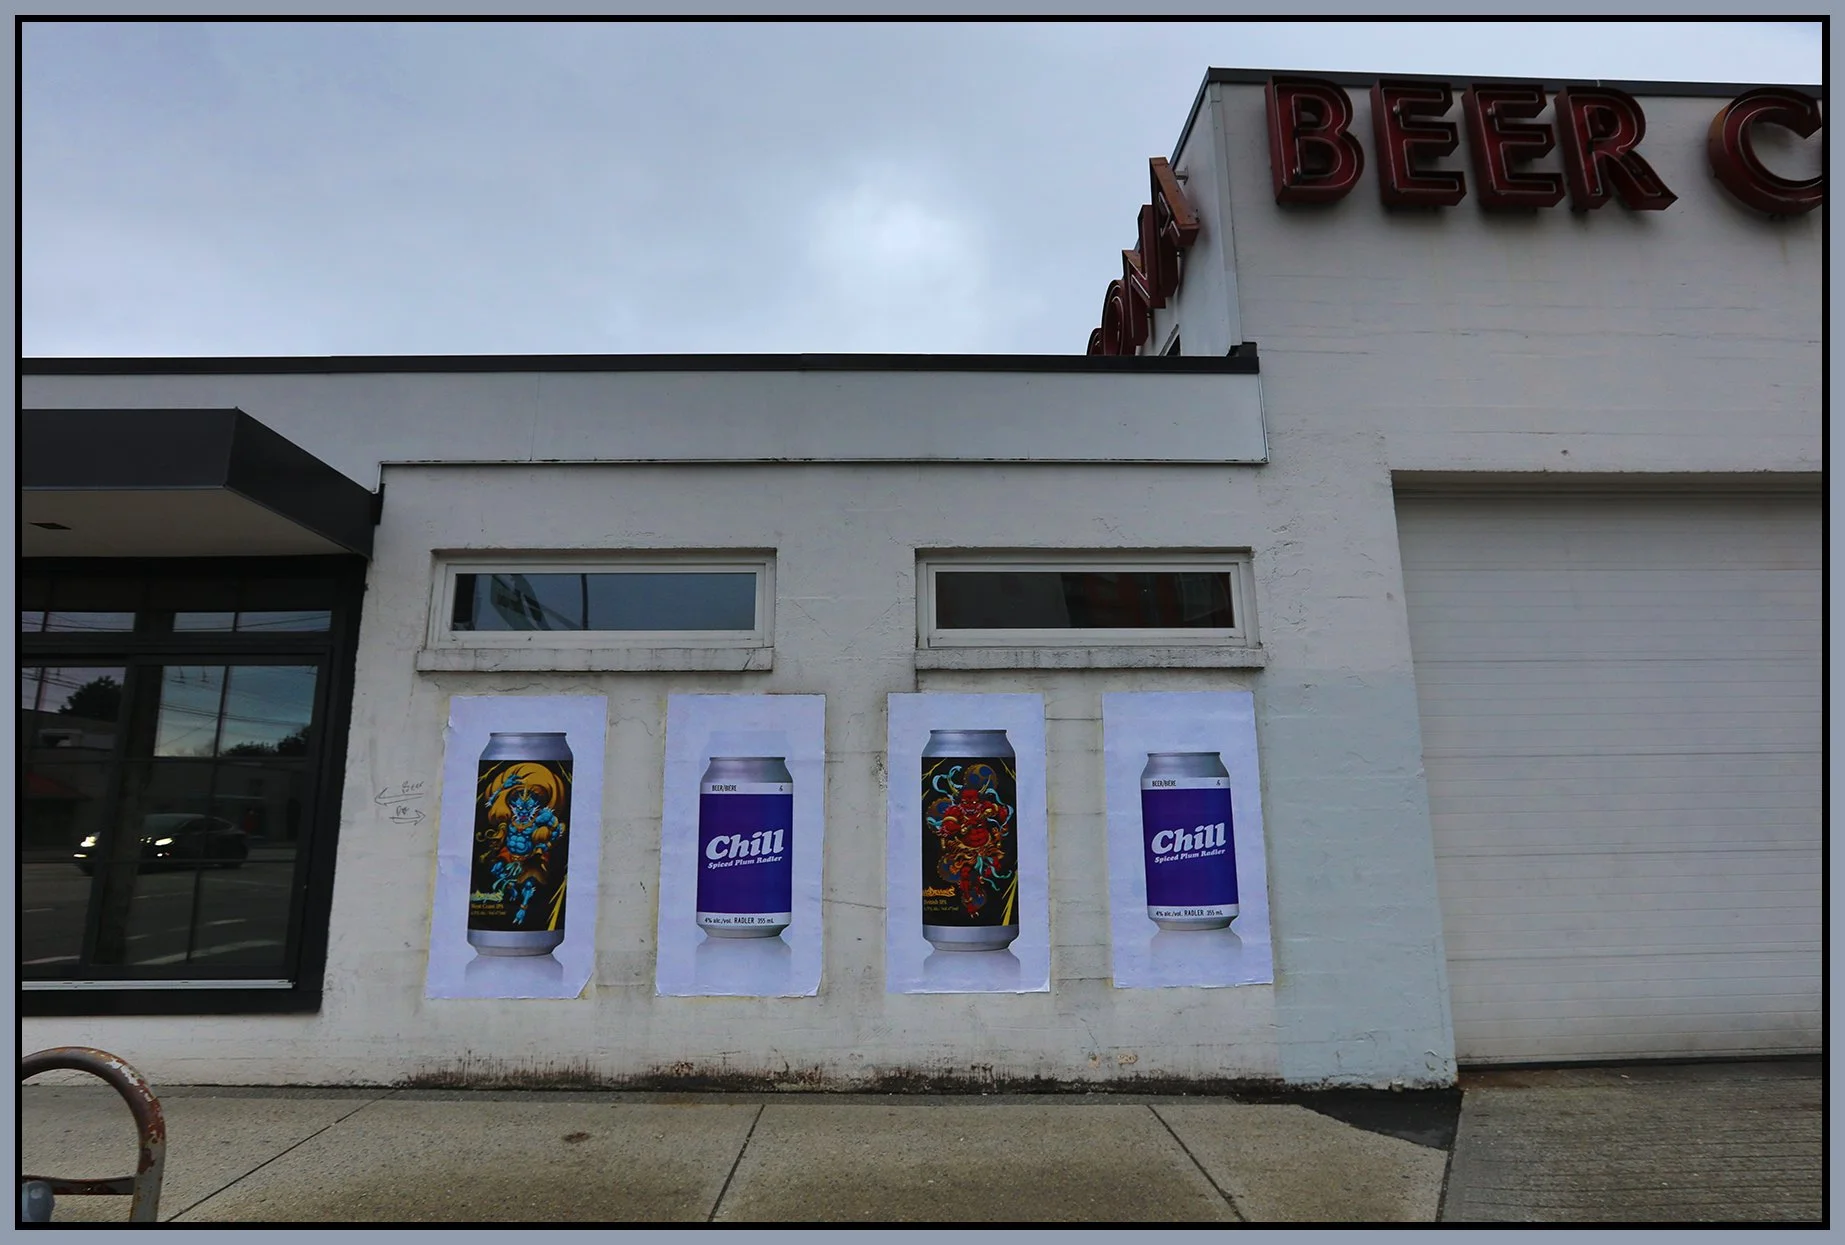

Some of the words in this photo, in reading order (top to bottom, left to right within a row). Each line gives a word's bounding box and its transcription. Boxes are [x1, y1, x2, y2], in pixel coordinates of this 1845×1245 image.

[1266, 76, 1678, 211] BEER
[705, 829, 784, 860] Chill
[1151, 822, 1226, 854] Chill
[707, 860, 733, 869] Spiced
[734, 858, 755, 866] Plum
[756, 855, 782, 864] Radler
[1154, 853, 1179, 863] Spiced
[1180, 851, 1199, 860] Plum
[1200, 848, 1226, 857] Radler
[733, 916, 755, 924] RADLER
[1184, 909, 1205, 917] RADLER
